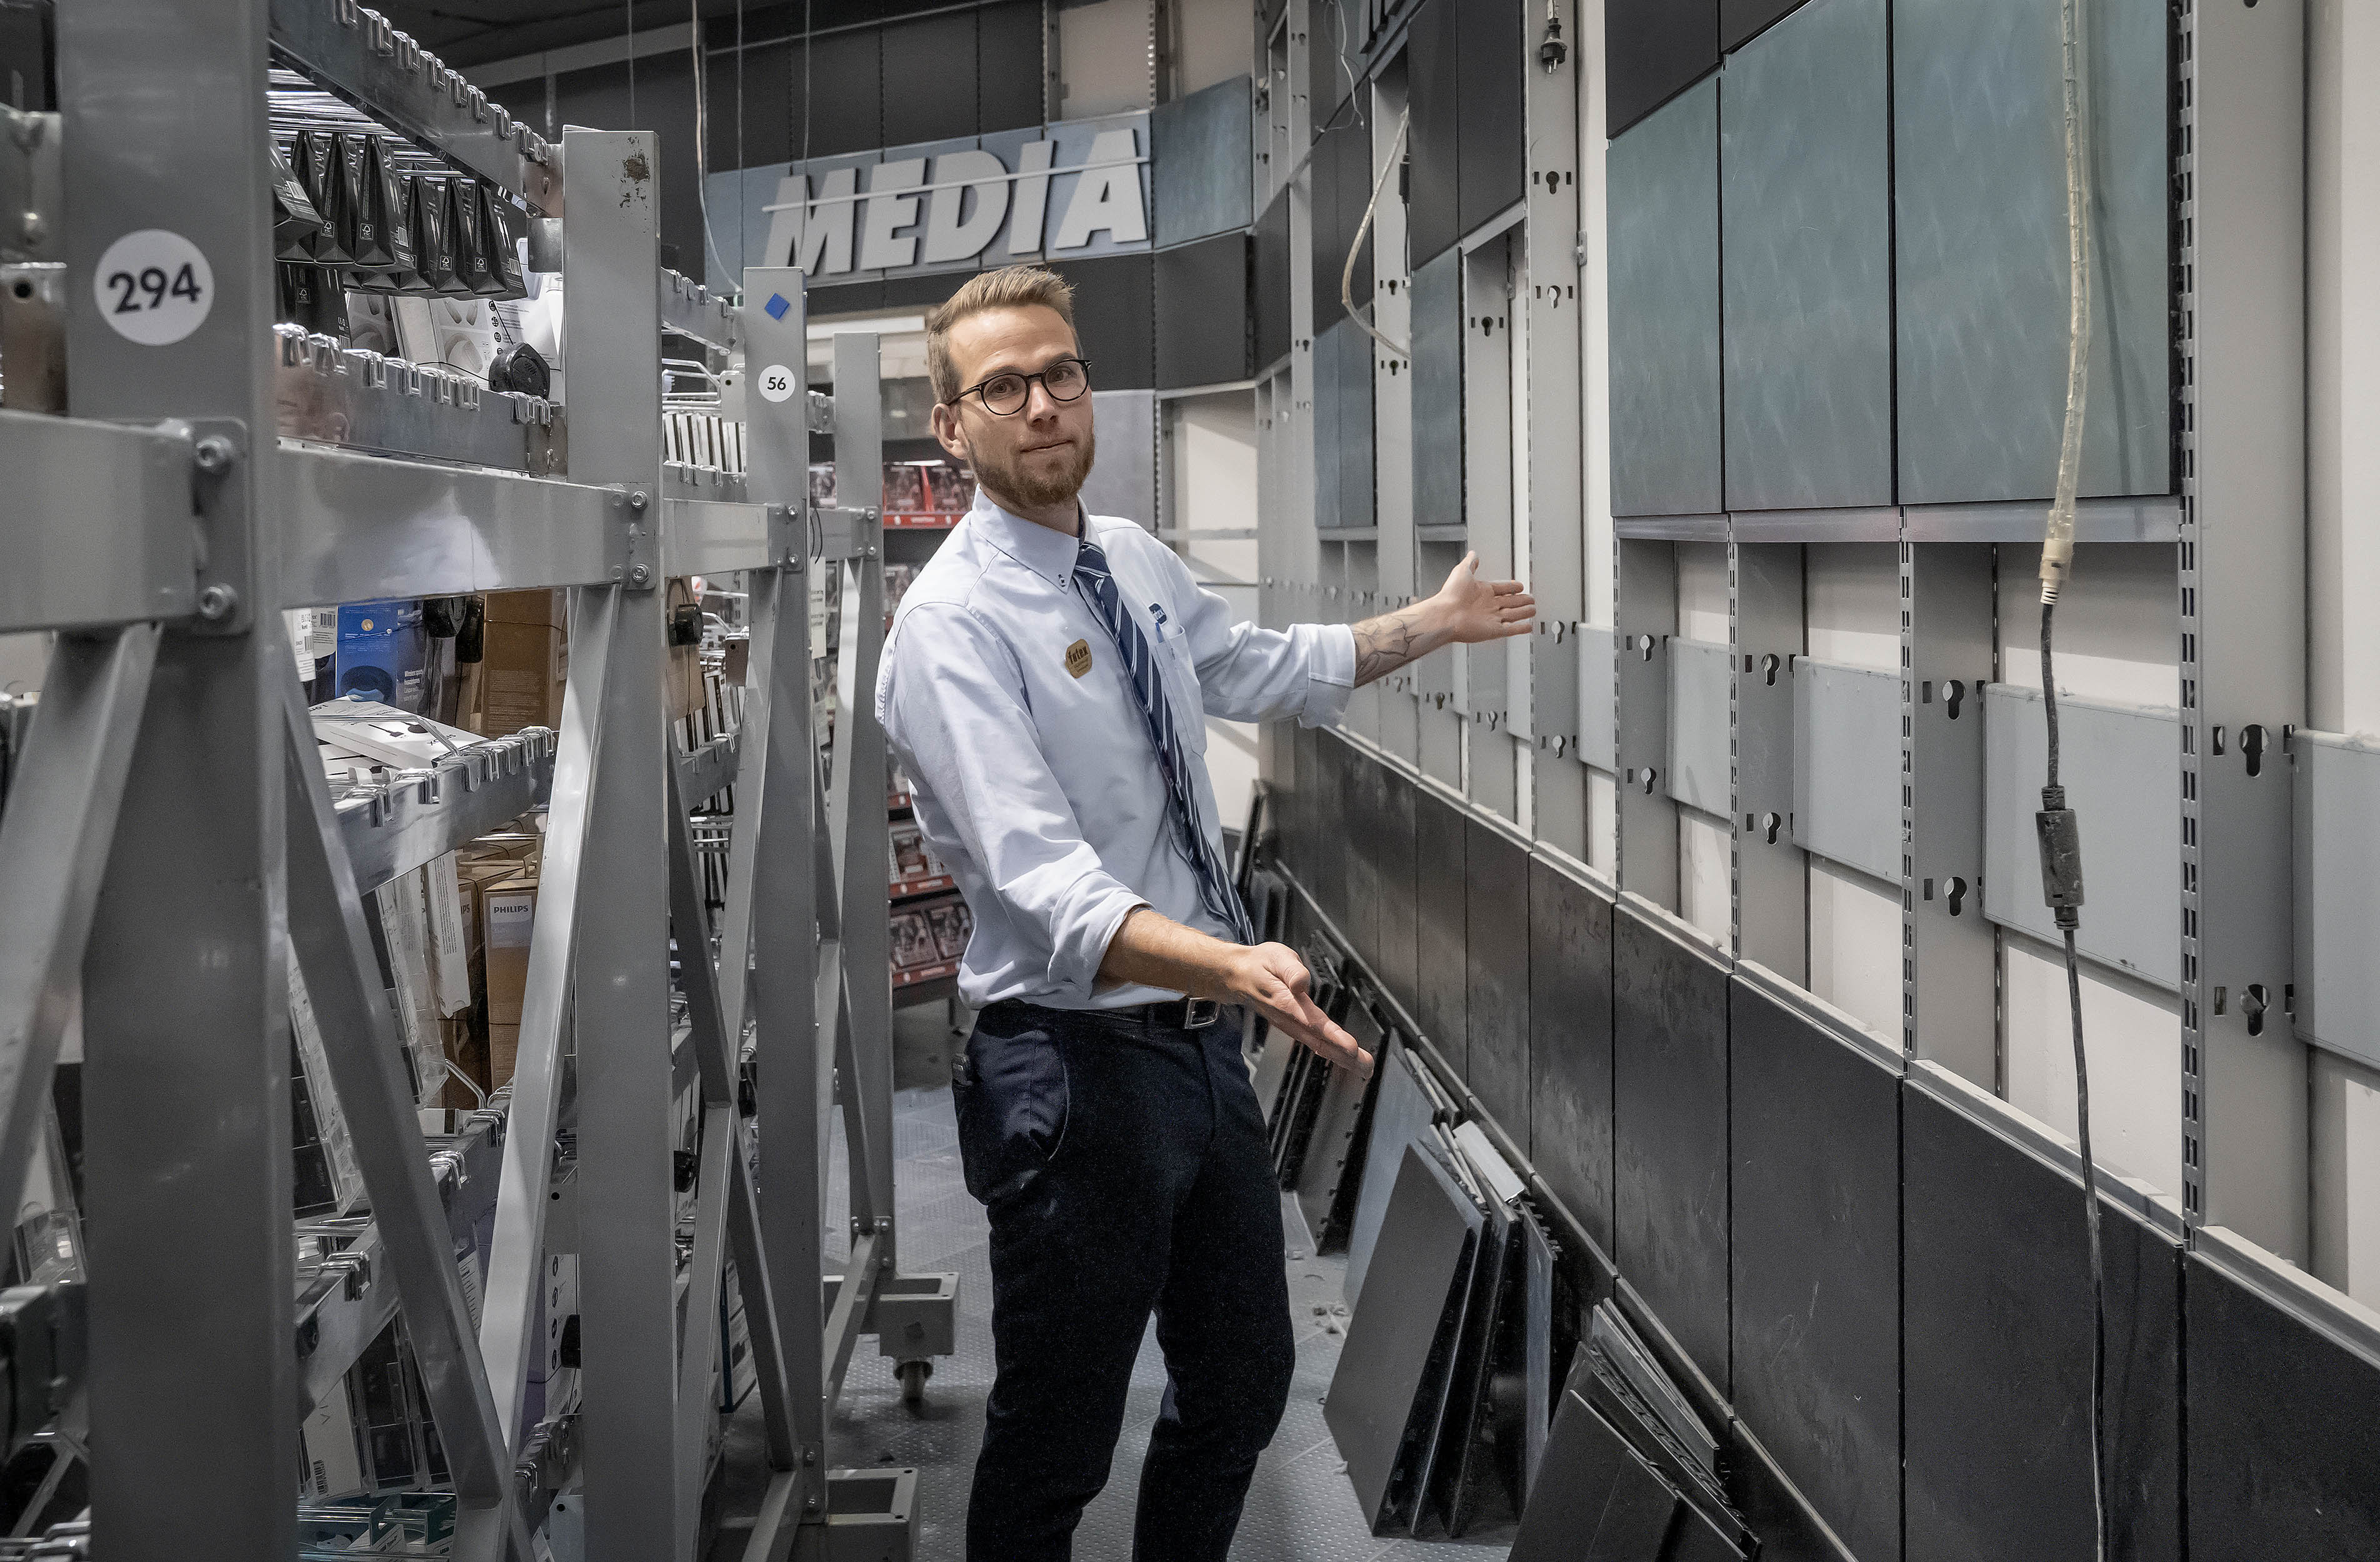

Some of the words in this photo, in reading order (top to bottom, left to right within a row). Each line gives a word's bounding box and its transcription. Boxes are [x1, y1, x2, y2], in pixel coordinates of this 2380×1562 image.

[763, 129, 1147, 277] MEDIA
[108, 263, 201, 313] 294
[767, 376, 786, 391] 56
[493, 904, 529, 914] PHILIPS
